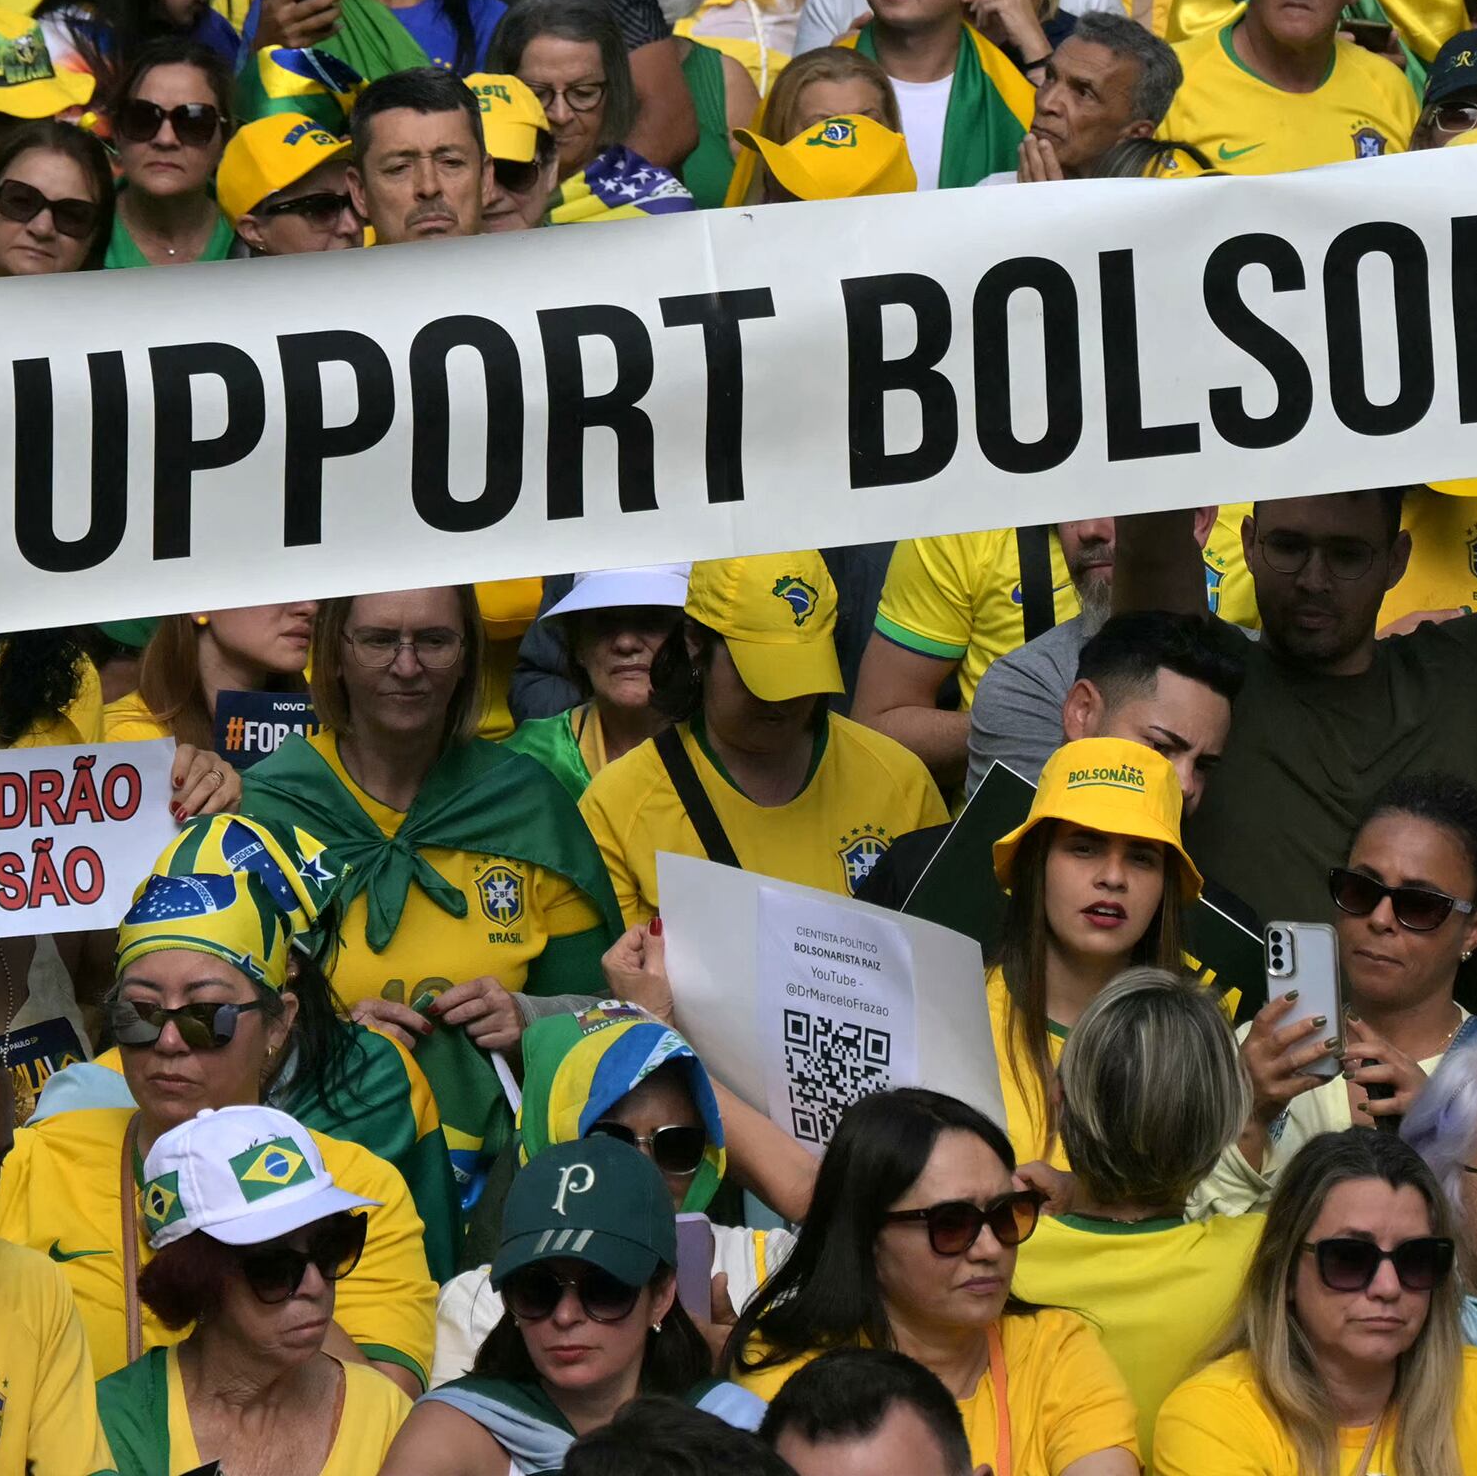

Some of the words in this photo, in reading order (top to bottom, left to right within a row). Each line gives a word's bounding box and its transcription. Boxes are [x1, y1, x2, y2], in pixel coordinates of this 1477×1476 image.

[274, 702, 306, 712] NOVO
[1067, 767, 1146, 788] BOLSONARO
[493, 890, 511, 899] CBF
[488, 932, 524, 945] BRASIL
[796, 926, 840, 945] CIENTISTA
[840, 934, 879, 955] POLÍTICO
[794, 942, 861, 967] BOLSONARISTA
[861, 958, 882, 972] RAIZ
[811, 966, 857, 988] YouTube
[785, 982, 891, 1018] @DrMarceloFrazao
